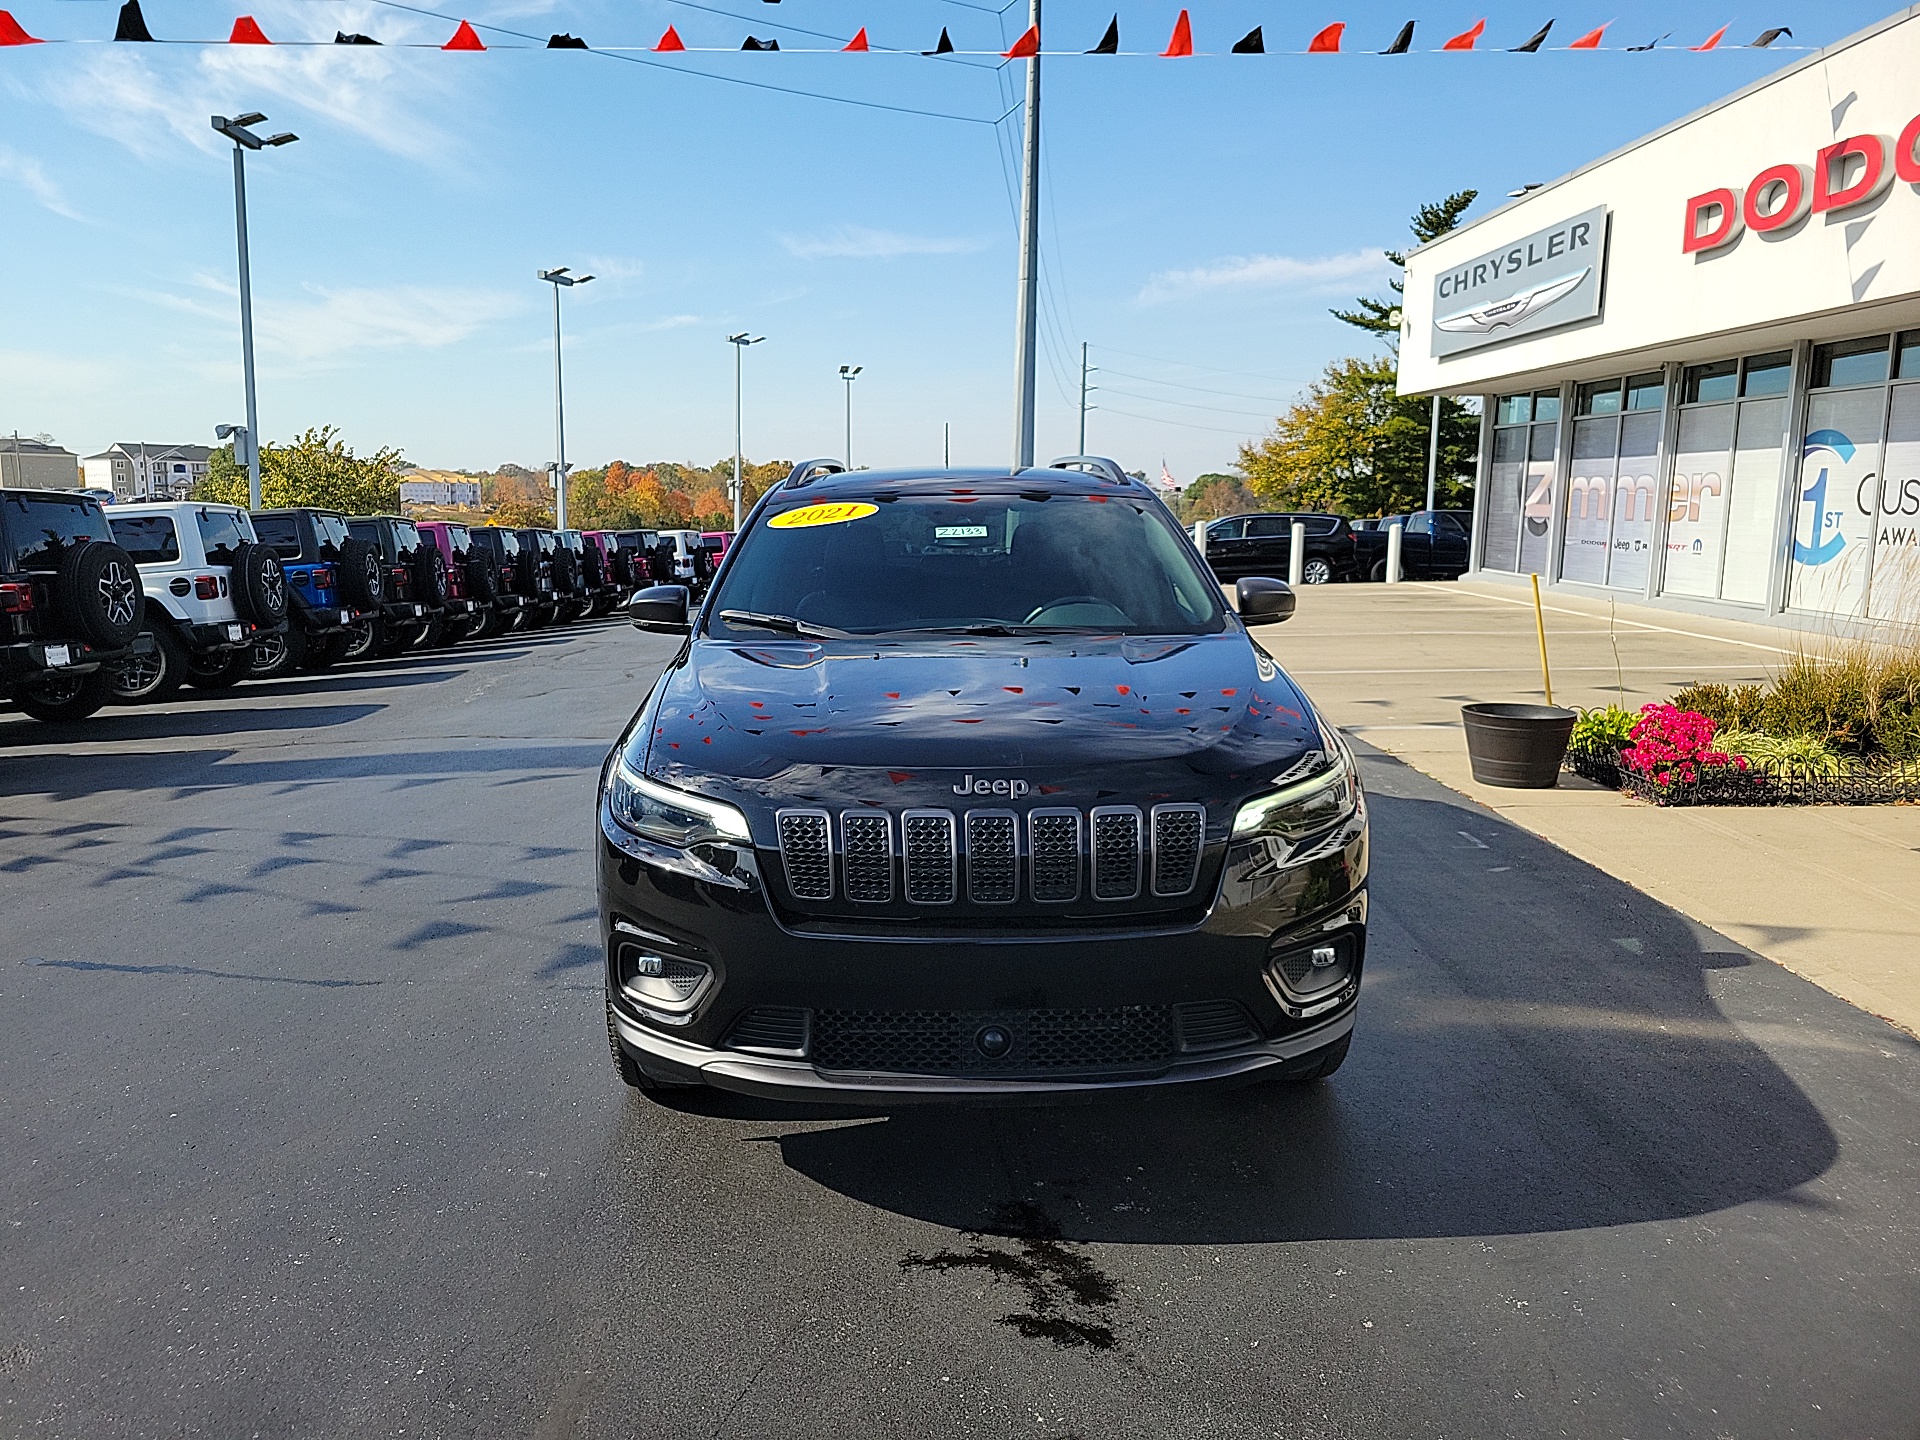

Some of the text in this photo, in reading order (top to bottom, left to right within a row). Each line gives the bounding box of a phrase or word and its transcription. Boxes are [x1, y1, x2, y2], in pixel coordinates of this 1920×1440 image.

[1438, 221, 1591, 299] CHRYSLER
[1525, 461, 1721, 522] Zmmer
[786, 505, 860, 525] 2021
[1613, 538, 1630, 552] Jeep
[1878, 526, 1920, 546] AWA
[953, 774, 1029, 800] Jeep
